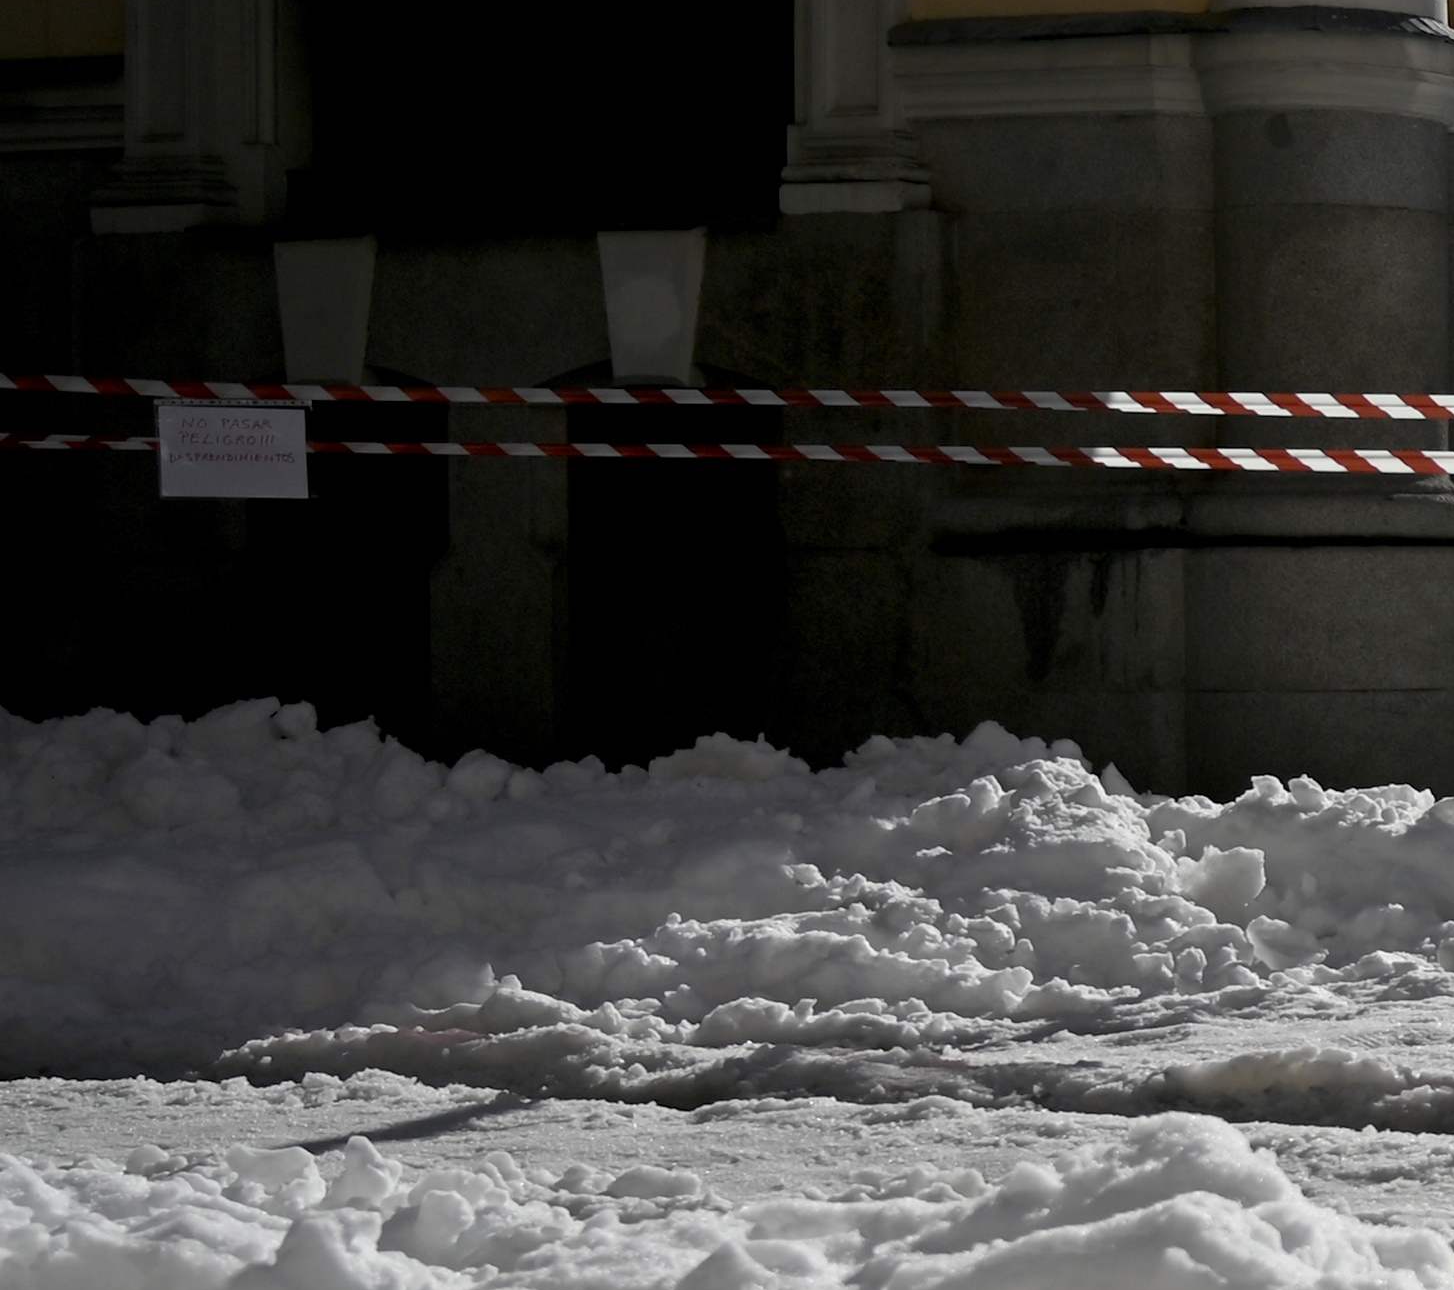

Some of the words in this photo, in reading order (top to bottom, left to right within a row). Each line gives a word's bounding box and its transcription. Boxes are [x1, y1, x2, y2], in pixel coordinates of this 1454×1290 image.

[181, 417, 208, 430] NO
[221, 417, 273, 430] PASAR
[168, 451, 296, 465] DESPRENDIMIENTOS
